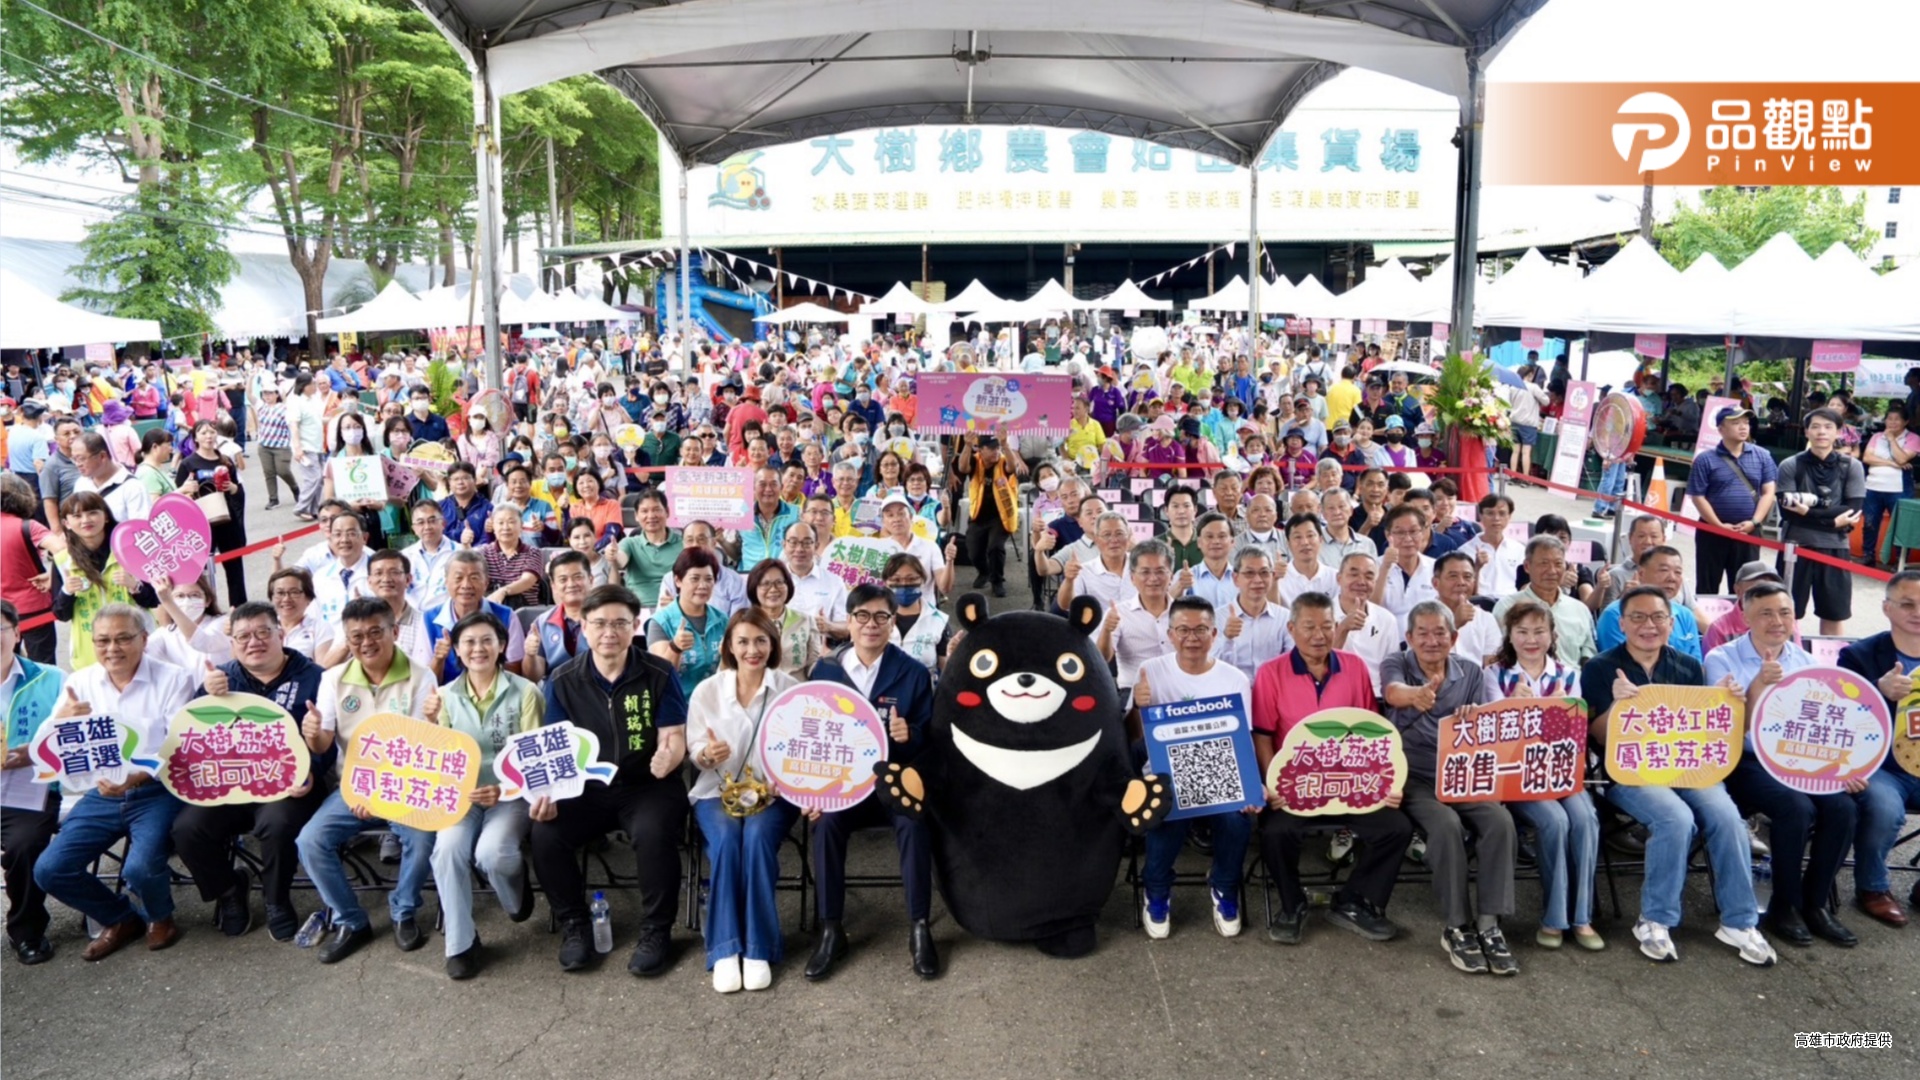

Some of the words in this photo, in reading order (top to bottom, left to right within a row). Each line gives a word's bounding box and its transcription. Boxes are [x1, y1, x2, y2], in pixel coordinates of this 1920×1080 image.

[133, 510, 183, 558] 台塑
[1165, 697, 1234, 717] facebook
[1804, 689, 1836, 703] 2024
[623, 694, 646, 751] 賴瑞隆
[803, 706, 833, 718] 2024
[1453, 706, 1544, 748] 大樹荔枝
[1620, 704, 1731, 734] 大樹紅牌
[1798, 699, 1847, 727] 夏祭
[54, 716, 117, 747] 高雄
[179, 721, 288, 754] 大樹荔枝
[514, 726, 571, 762] 高雄
[799, 717, 845, 742] 夏祭
[1782, 719, 1857, 749] 新鮮市
[59, 743, 122, 775] 首選
[360, 733, 467, 780] 大樹紅牌
[787, 738, 855, 765] 新鮮市
[1292, 736, 1392, 767] 大樹荔枝
[1442, 738, 1577, 795] 銷售一路發
[1616, 740, 1728, 769] 鳳梨荔枝
[189, 759, 282, 788] 很可以
[521, 753, 578, 790] 首選
[1295, 772, 1379, 798] 很可以
[351, 767, 459, 812] 鳳梨荔枝
